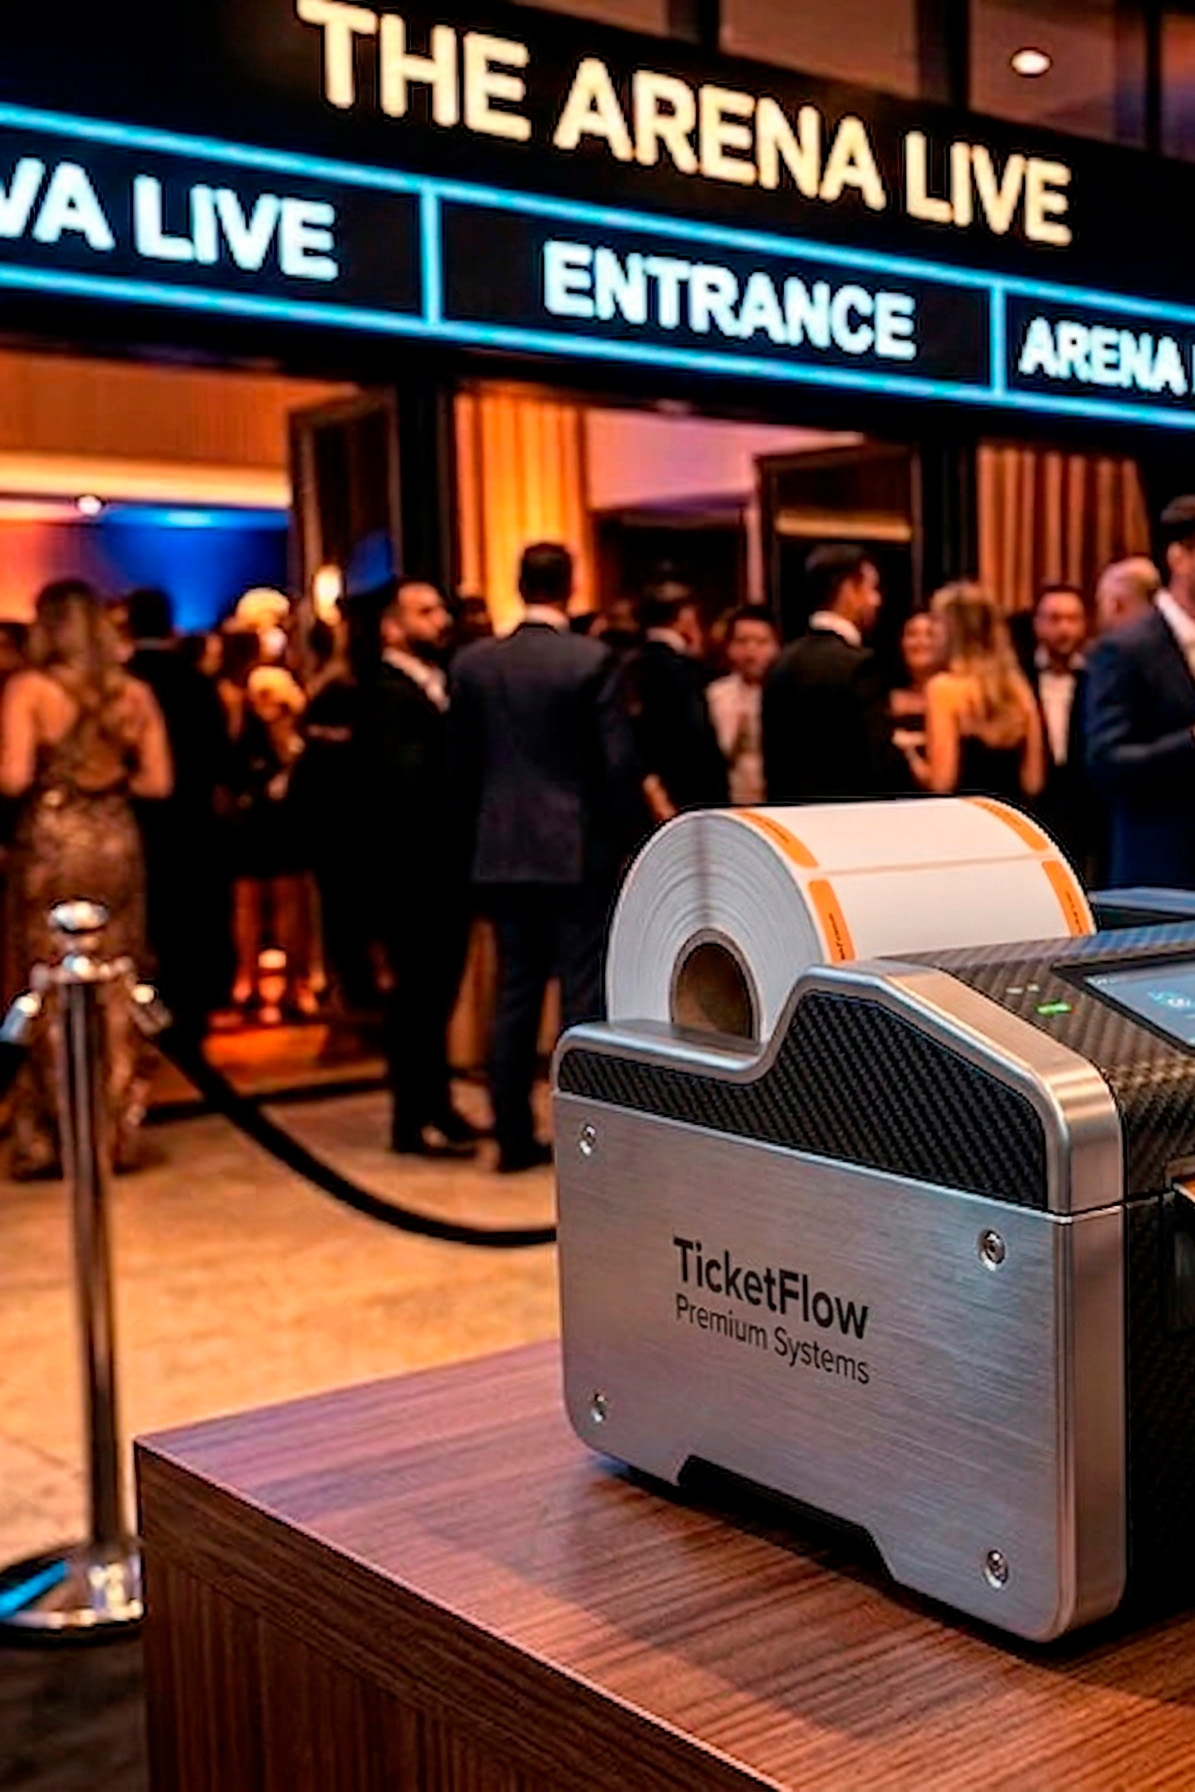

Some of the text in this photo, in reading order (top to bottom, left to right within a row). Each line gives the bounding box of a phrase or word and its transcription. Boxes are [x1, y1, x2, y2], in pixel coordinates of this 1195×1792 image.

[297, 0, 1073, 246] THE ARENA LIVE
[132, 173, 340, 282] LIVE
[543, 240, 917, 361] ENTRANCE
[1018, 316, 1188, 396] ARENA
[673, 1236, 869, 1340] TicketFlow
[675, 1293, 870, 1385] Premium Systems
